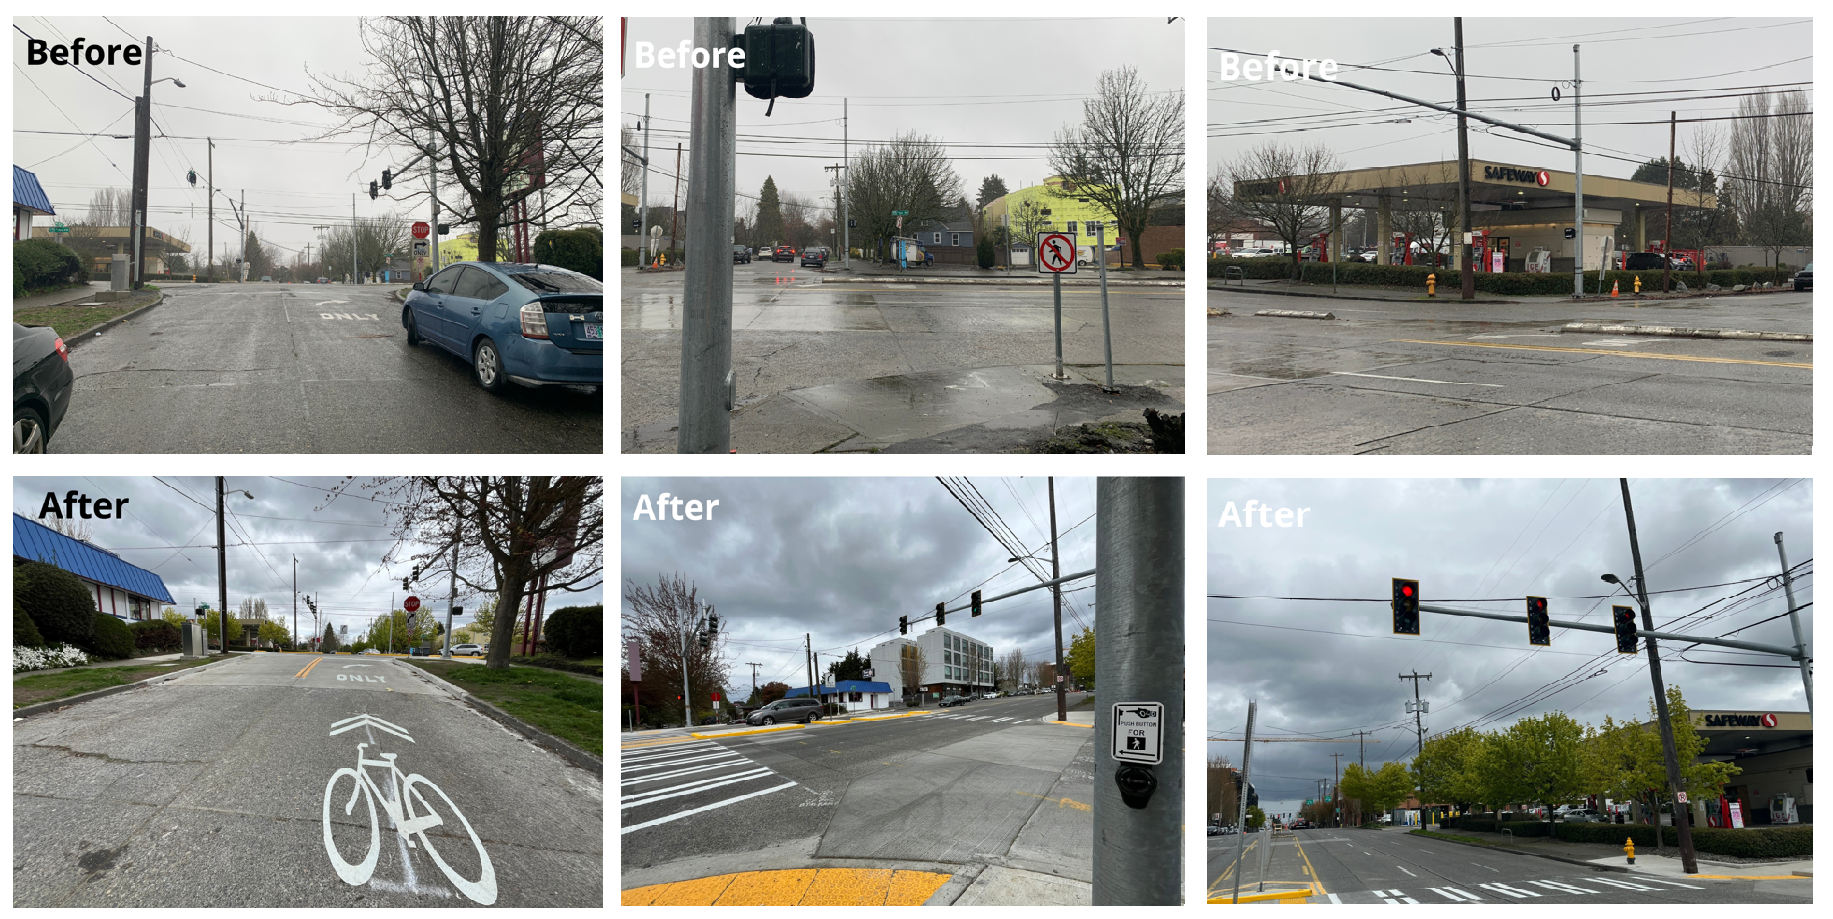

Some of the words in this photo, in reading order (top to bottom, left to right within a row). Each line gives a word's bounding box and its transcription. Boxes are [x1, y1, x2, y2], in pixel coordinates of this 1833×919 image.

[1485, 166, 1537, 184] SAFEWAY
[412, 225, 429, 234] STOP
[319, 313, 380, 321] ONLY
[336, 674, 386, 683] ONLY
[1705, 714, 1761, 727] SAFEWAY
